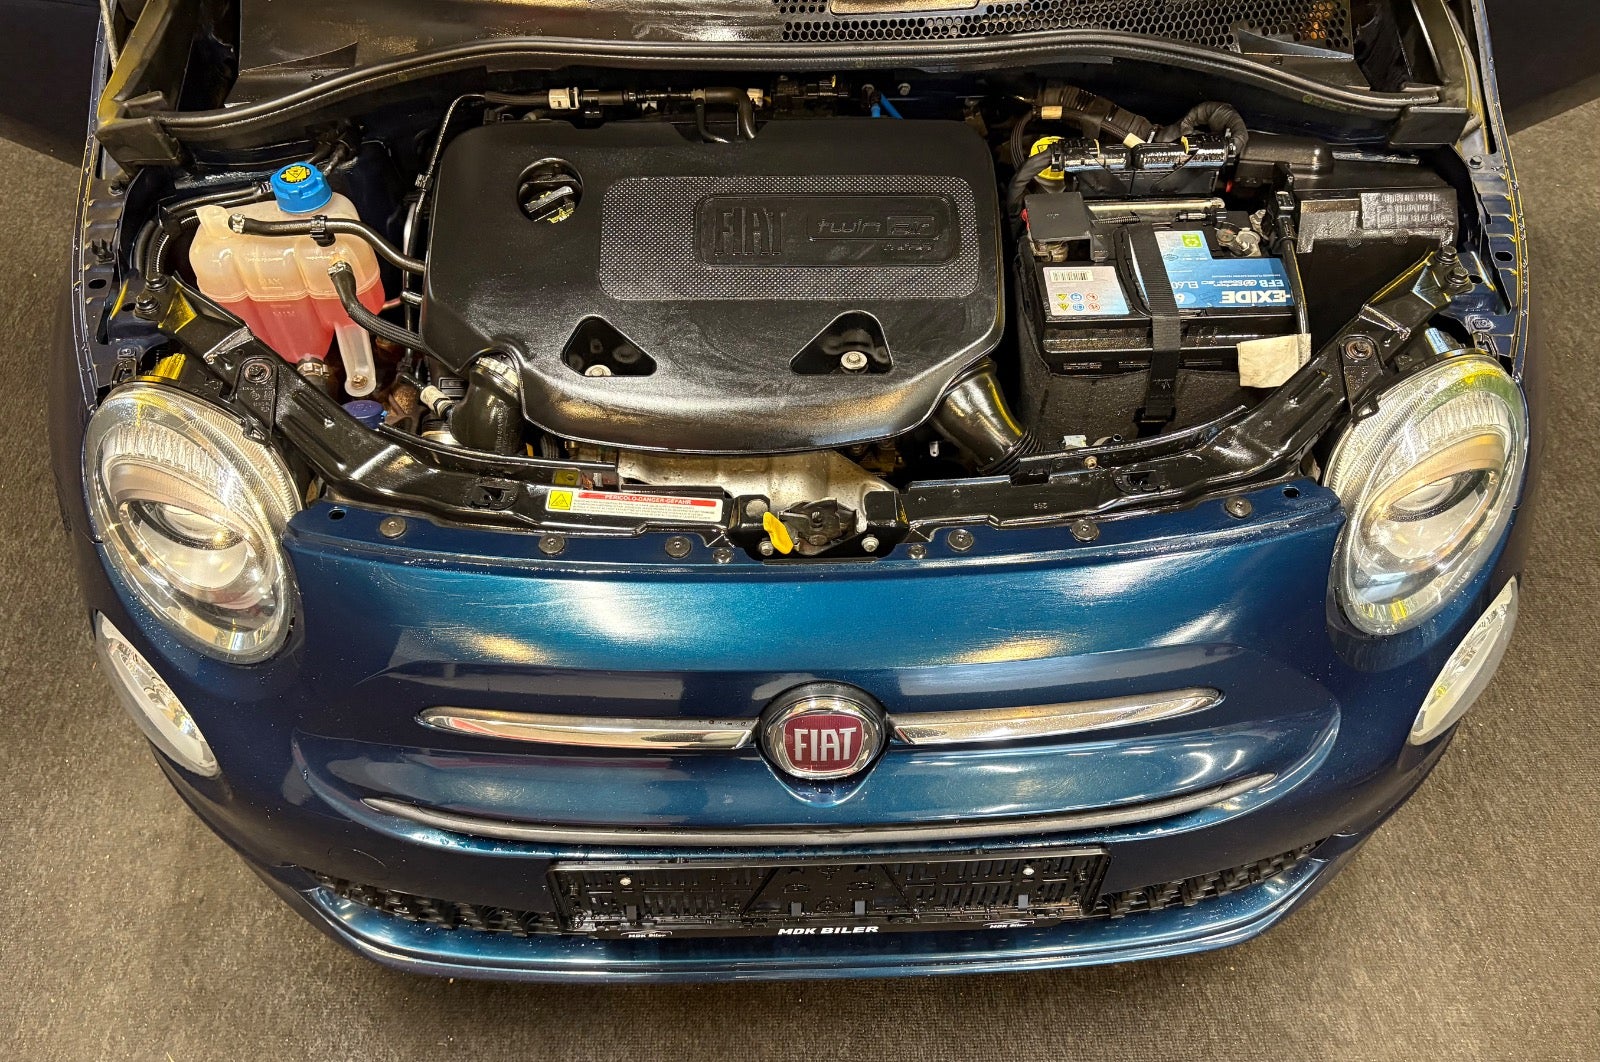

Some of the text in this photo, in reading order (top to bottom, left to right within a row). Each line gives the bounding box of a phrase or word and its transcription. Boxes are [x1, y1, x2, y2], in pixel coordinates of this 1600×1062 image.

[714, 207, 788, 256] FIAT
[1259, 279, 1285, 288] EFB
[1221, 289, 1290, 304] EXIDE
[794, 727, 857, 762] FIAT
[777, 926, 879, 936] MDK BILER
